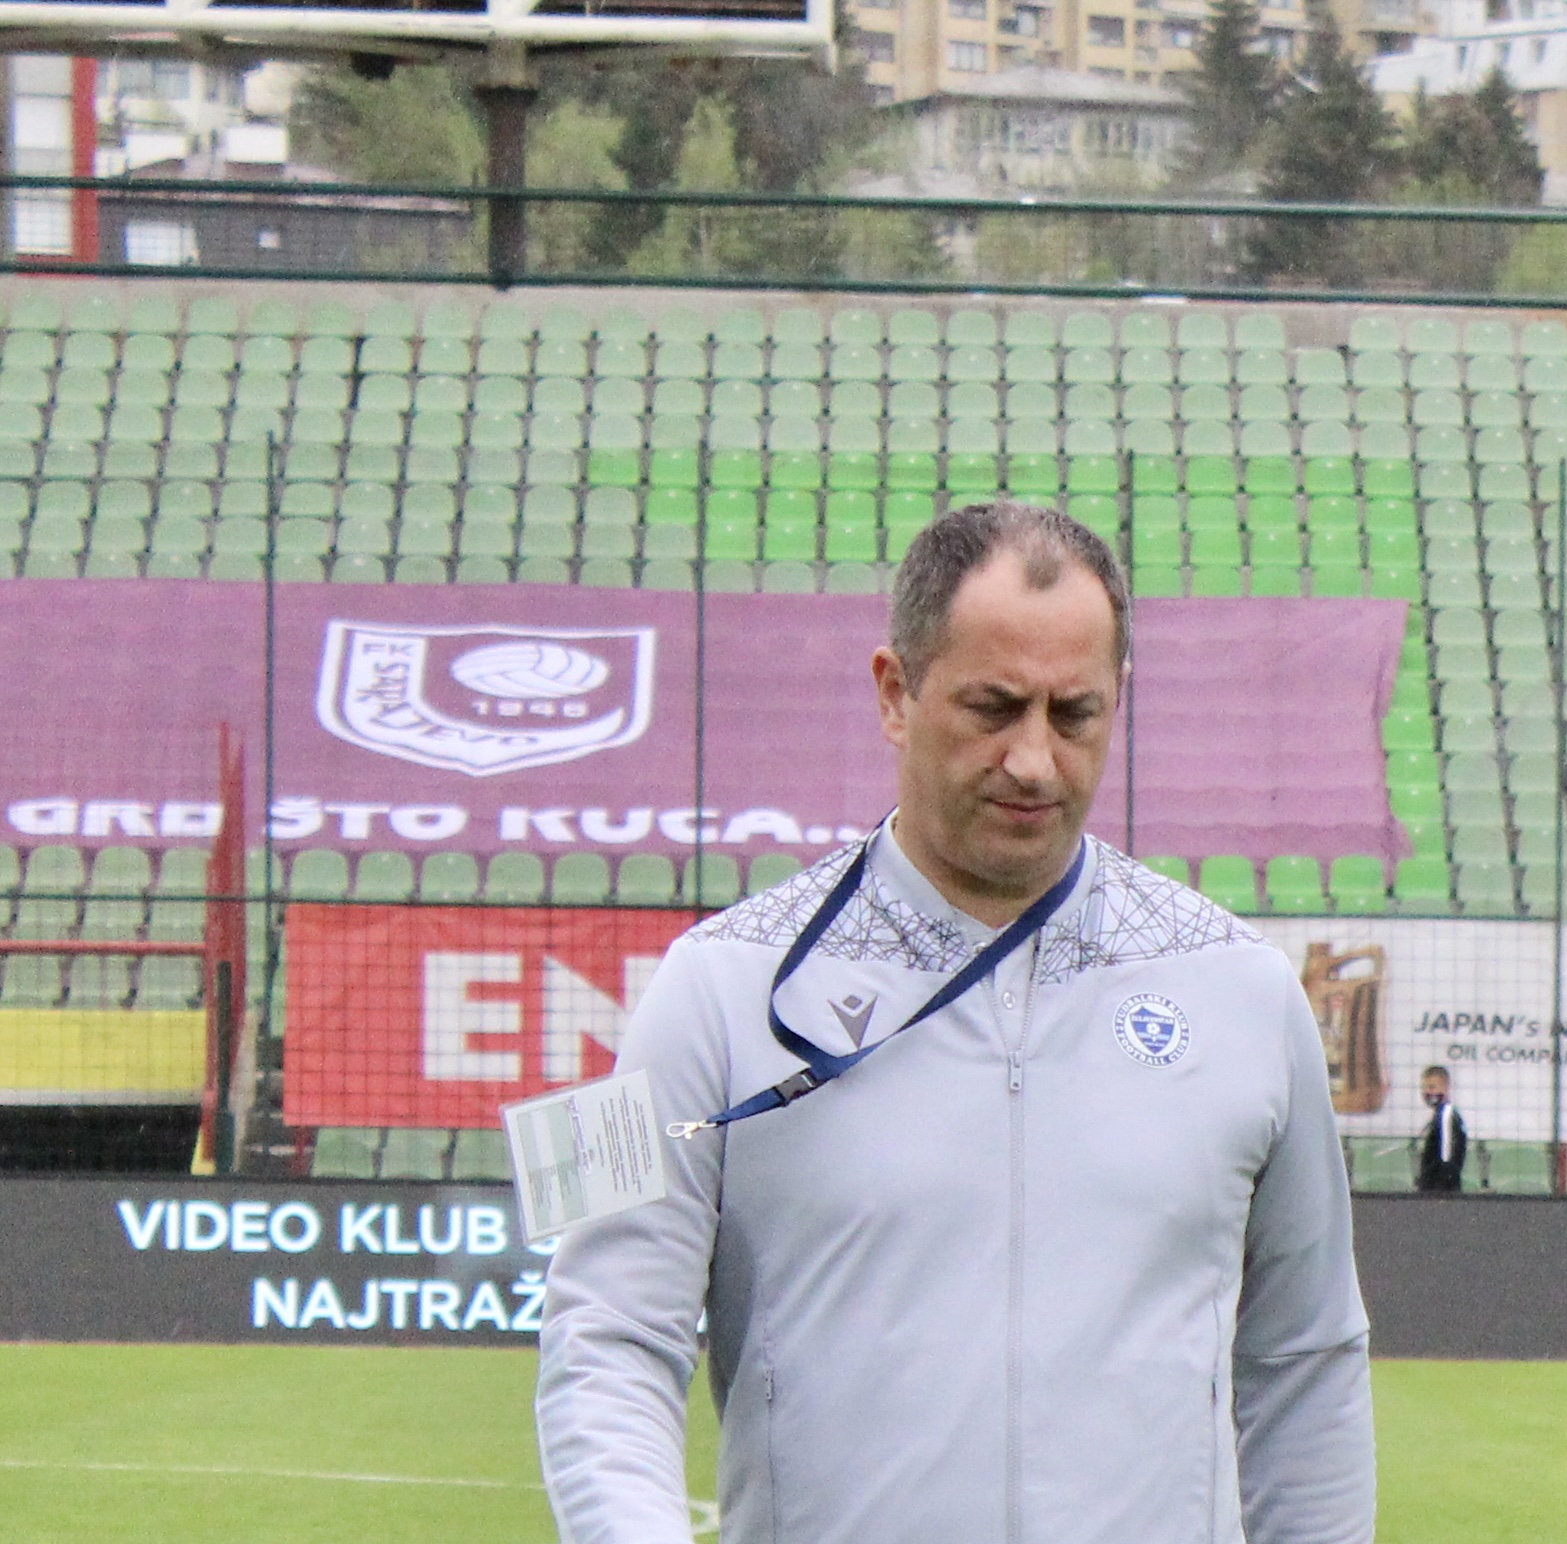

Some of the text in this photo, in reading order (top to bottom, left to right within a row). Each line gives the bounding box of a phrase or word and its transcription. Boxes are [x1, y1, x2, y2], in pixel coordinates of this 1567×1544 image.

[1448, 1043, 1478, 1061] OIL
[118, 1200, 322, 1255] VIDEO
[339, 1203, 508, 1256] KLUB
